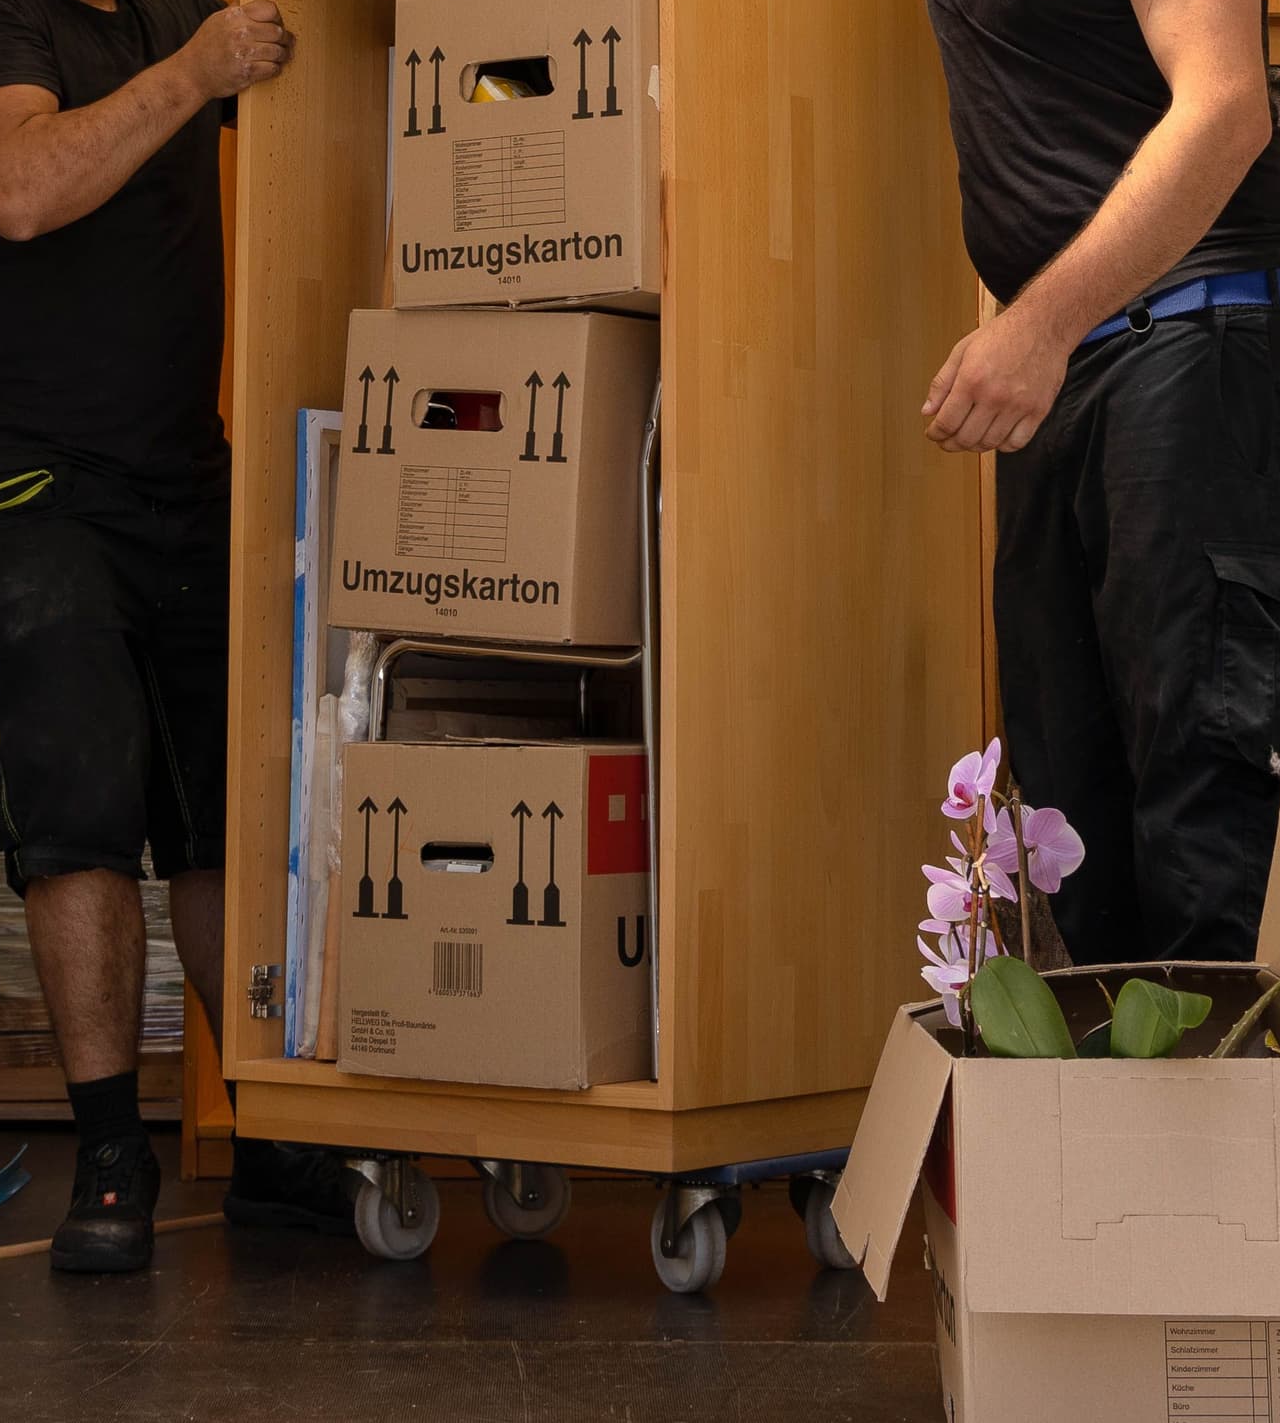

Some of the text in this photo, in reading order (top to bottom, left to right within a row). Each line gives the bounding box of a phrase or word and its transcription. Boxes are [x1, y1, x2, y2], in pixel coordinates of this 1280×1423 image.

[402, 231, 623, 275] Umzugskarton
[497, 276, 521, 285] 14010
[342, 559, 560, 605] Umzugskarton
[434, 607, 458, 617] 14010
[617, 916, 650, 967] U
[351, 1017, 380, 1026] HELLWEG
[381, 1019, 390, 1027] Die
[351, 1026, 368, 1034] GmbH
[386, 1028, 395, 1036] KG
[368, 1045, 395, 1054] Dortmund
[1169, 1327, 1216, 1335] Wohnzimmer
[1170, 1346, 1218, 1354] Schlafzimmer
[1171, 1365, 1220, 1373] Kinderzimmer
[1171, 1383, 1194, 1392] Küche
[1172, 1401, 1190, 1410] Büro
